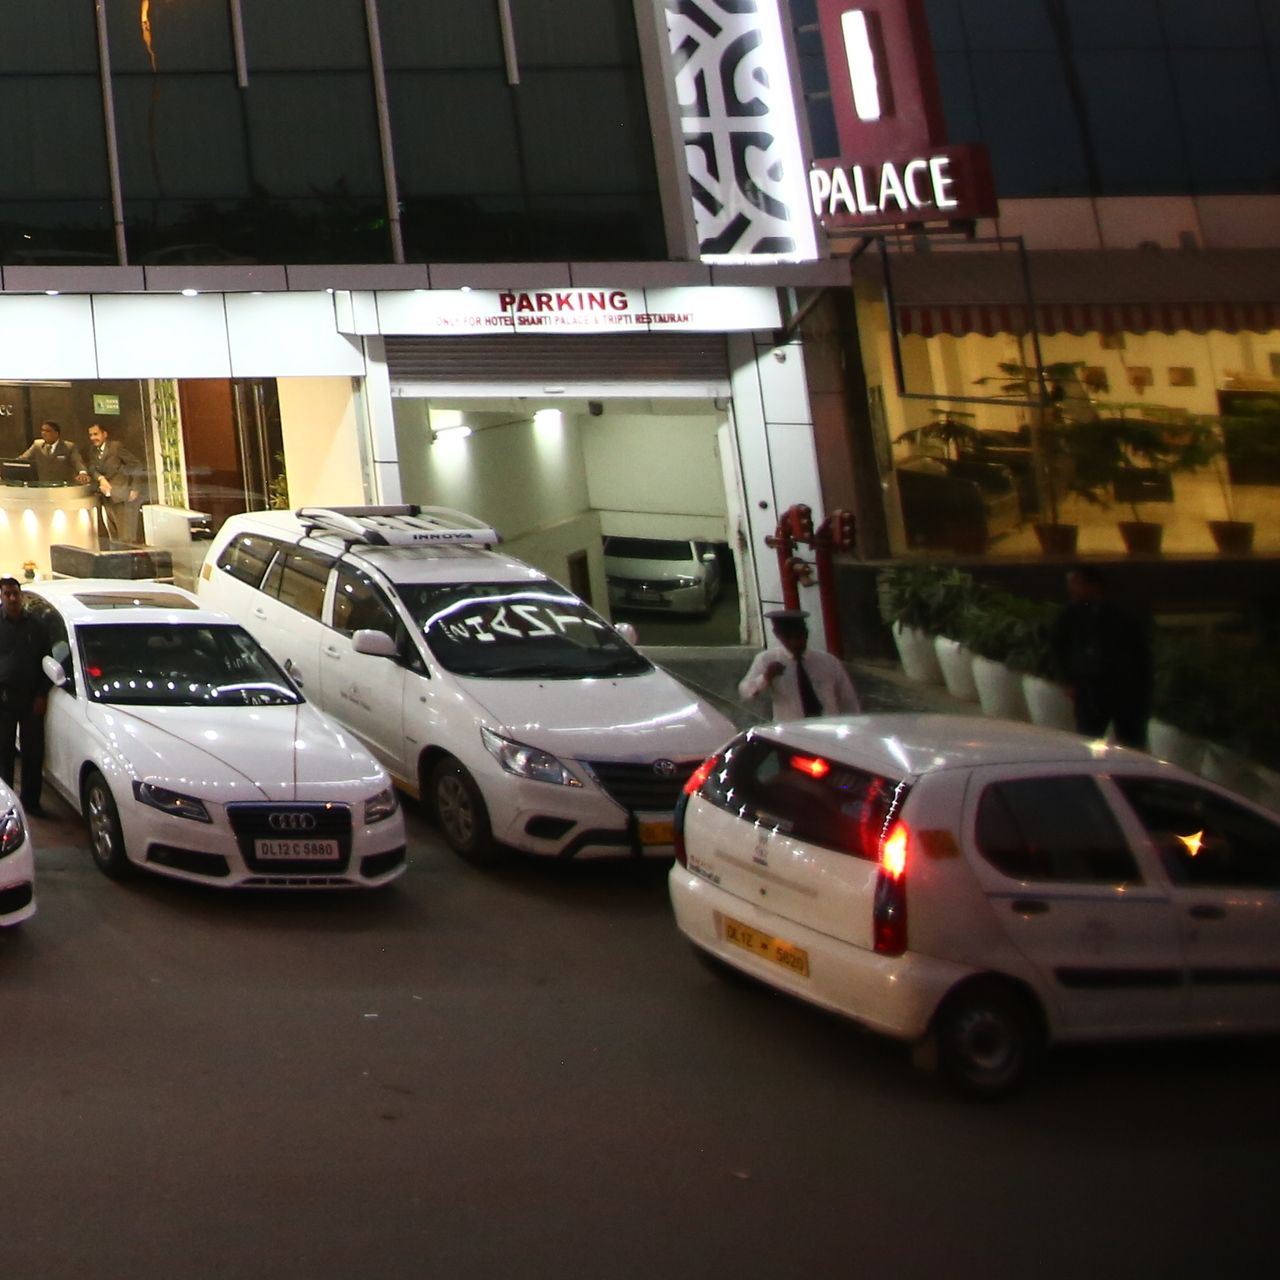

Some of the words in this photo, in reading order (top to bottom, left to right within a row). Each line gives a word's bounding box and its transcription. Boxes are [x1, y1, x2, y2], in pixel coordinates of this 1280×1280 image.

[810, 155, 958, 217] PALACE
[499, 291, 628, 312] PARKING
[463, 316, 482, 326] FOR
[485, 316, 515, 326] HOTEL
[518, 315, 552, 326] SHANTI
[554, 315, 589, 325] PALACE
[602, 314, 633, 324] TRIPTI
[635, 313, 694, 324] RESTAURANT
[413, 533, 474, 541] INNOVA
